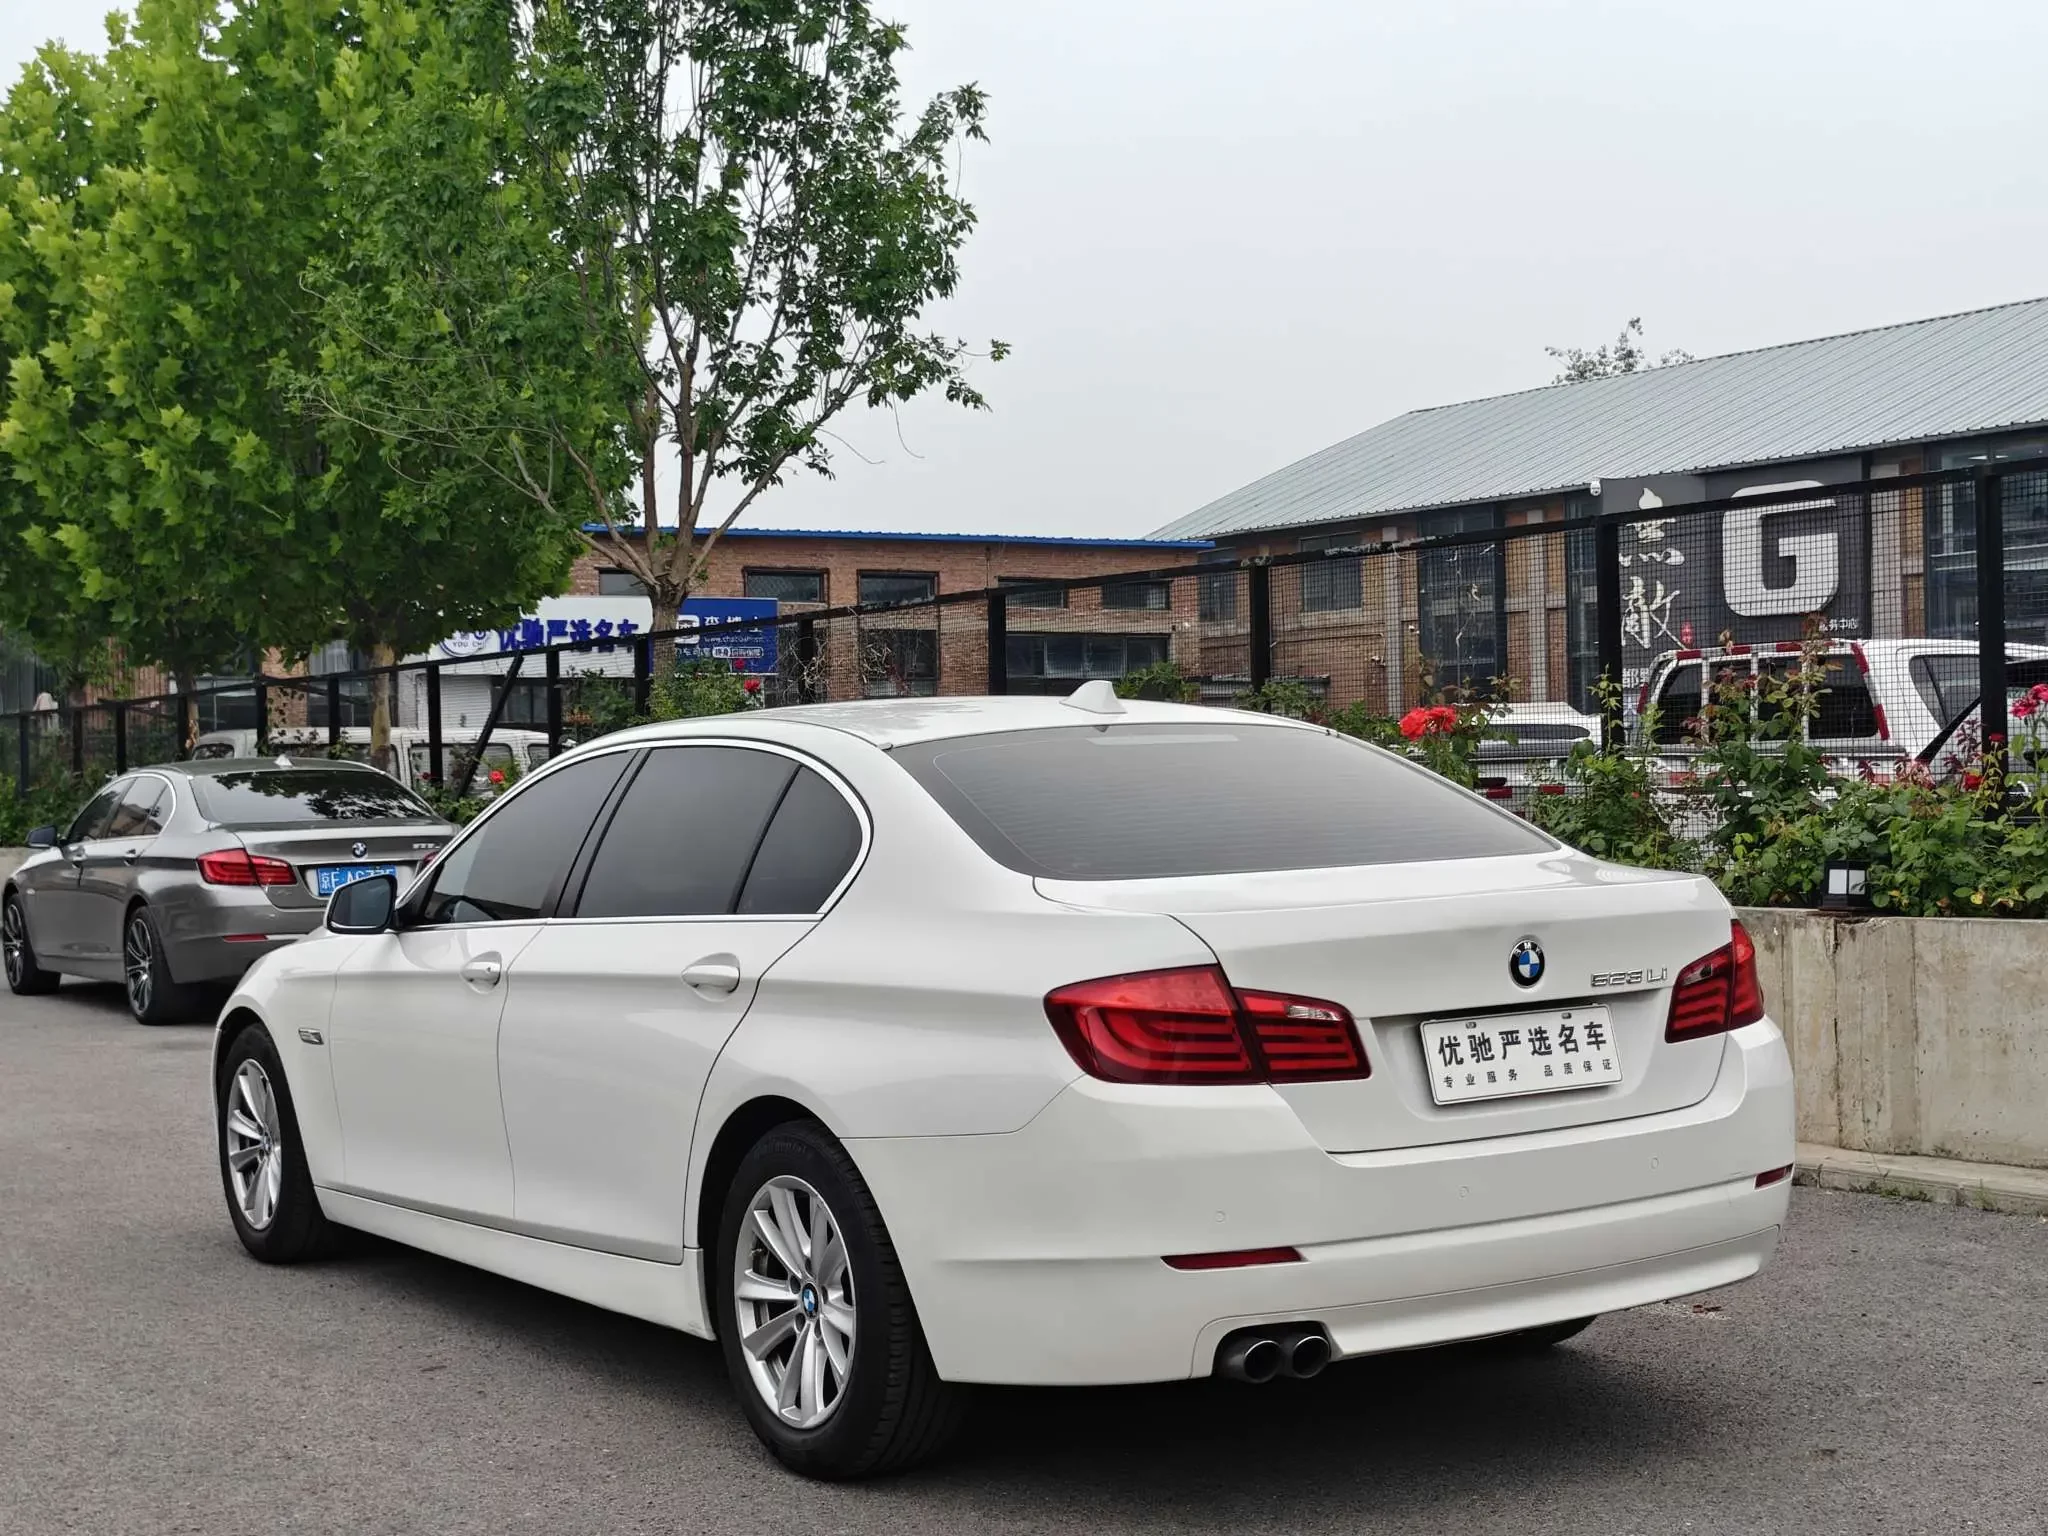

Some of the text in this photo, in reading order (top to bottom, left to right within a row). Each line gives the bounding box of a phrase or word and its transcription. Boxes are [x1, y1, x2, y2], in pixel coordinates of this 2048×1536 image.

[1722, 480, 1839, 617] G
[1590, 968, 1643, 987] 523
[1438, 1021, 1608, 1067] 优驰严选名车
[1443, 1058, 1613, 1089] 专业服务 品质保证
